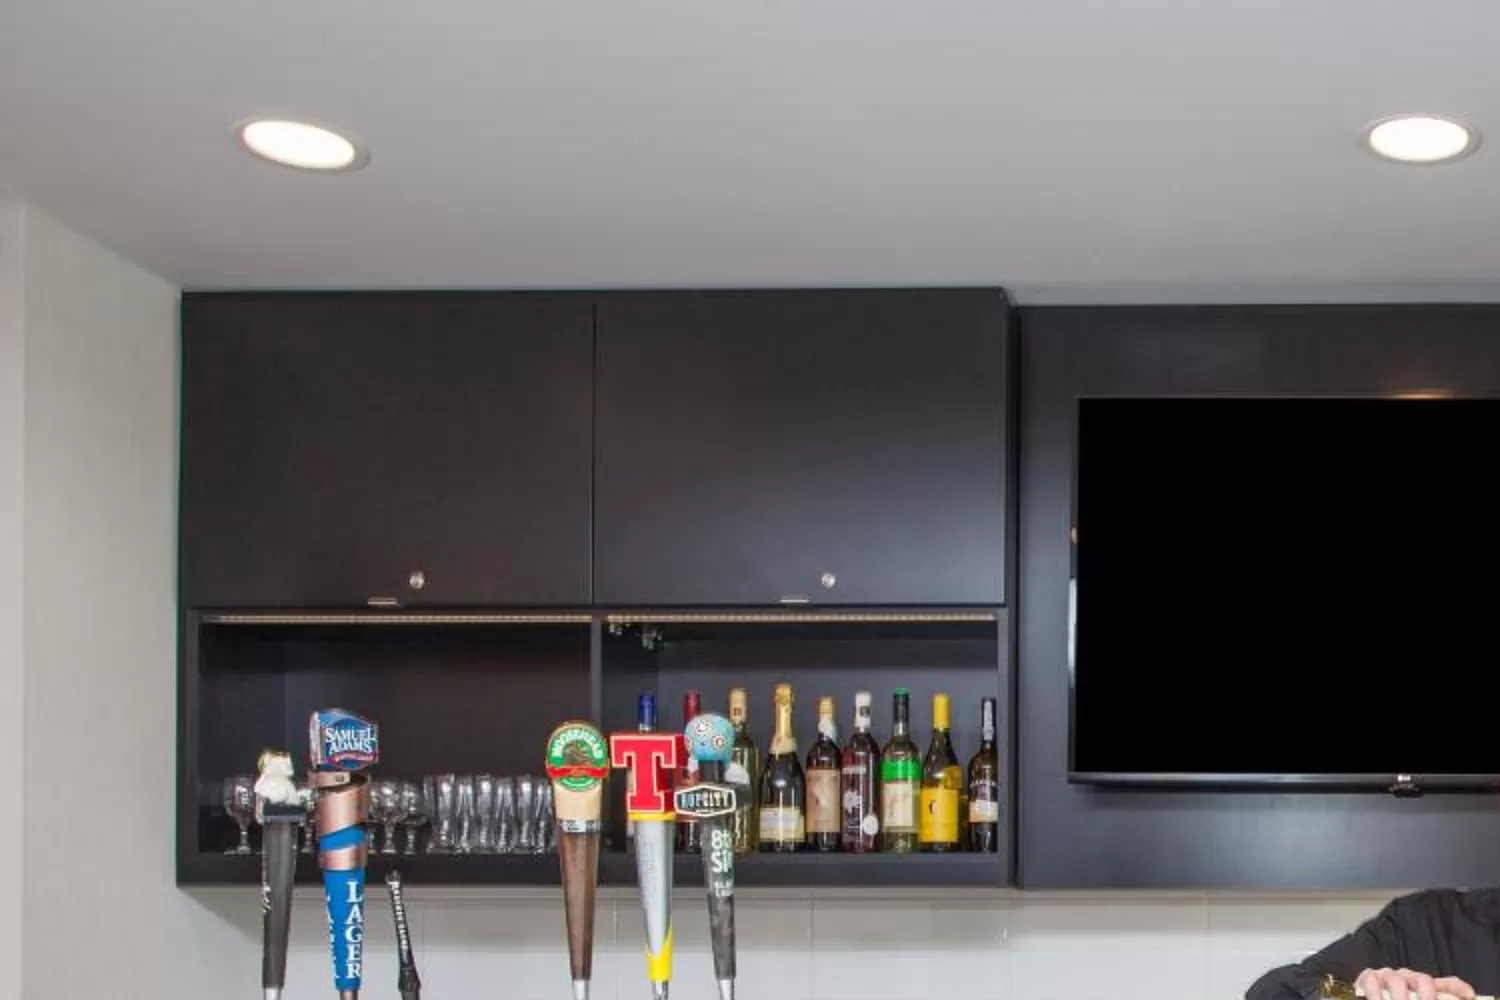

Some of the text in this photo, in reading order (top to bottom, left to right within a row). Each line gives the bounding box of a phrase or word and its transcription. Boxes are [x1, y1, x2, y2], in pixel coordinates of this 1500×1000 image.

[325, 726, 377, 743] SAMUEL
[328, 739, 373, 757] ADAMS
[550, 728, 605, 760] MOOSEHEAD
[609, 735, 677, 813] T
[345, 881, 364, 979] LAGER
